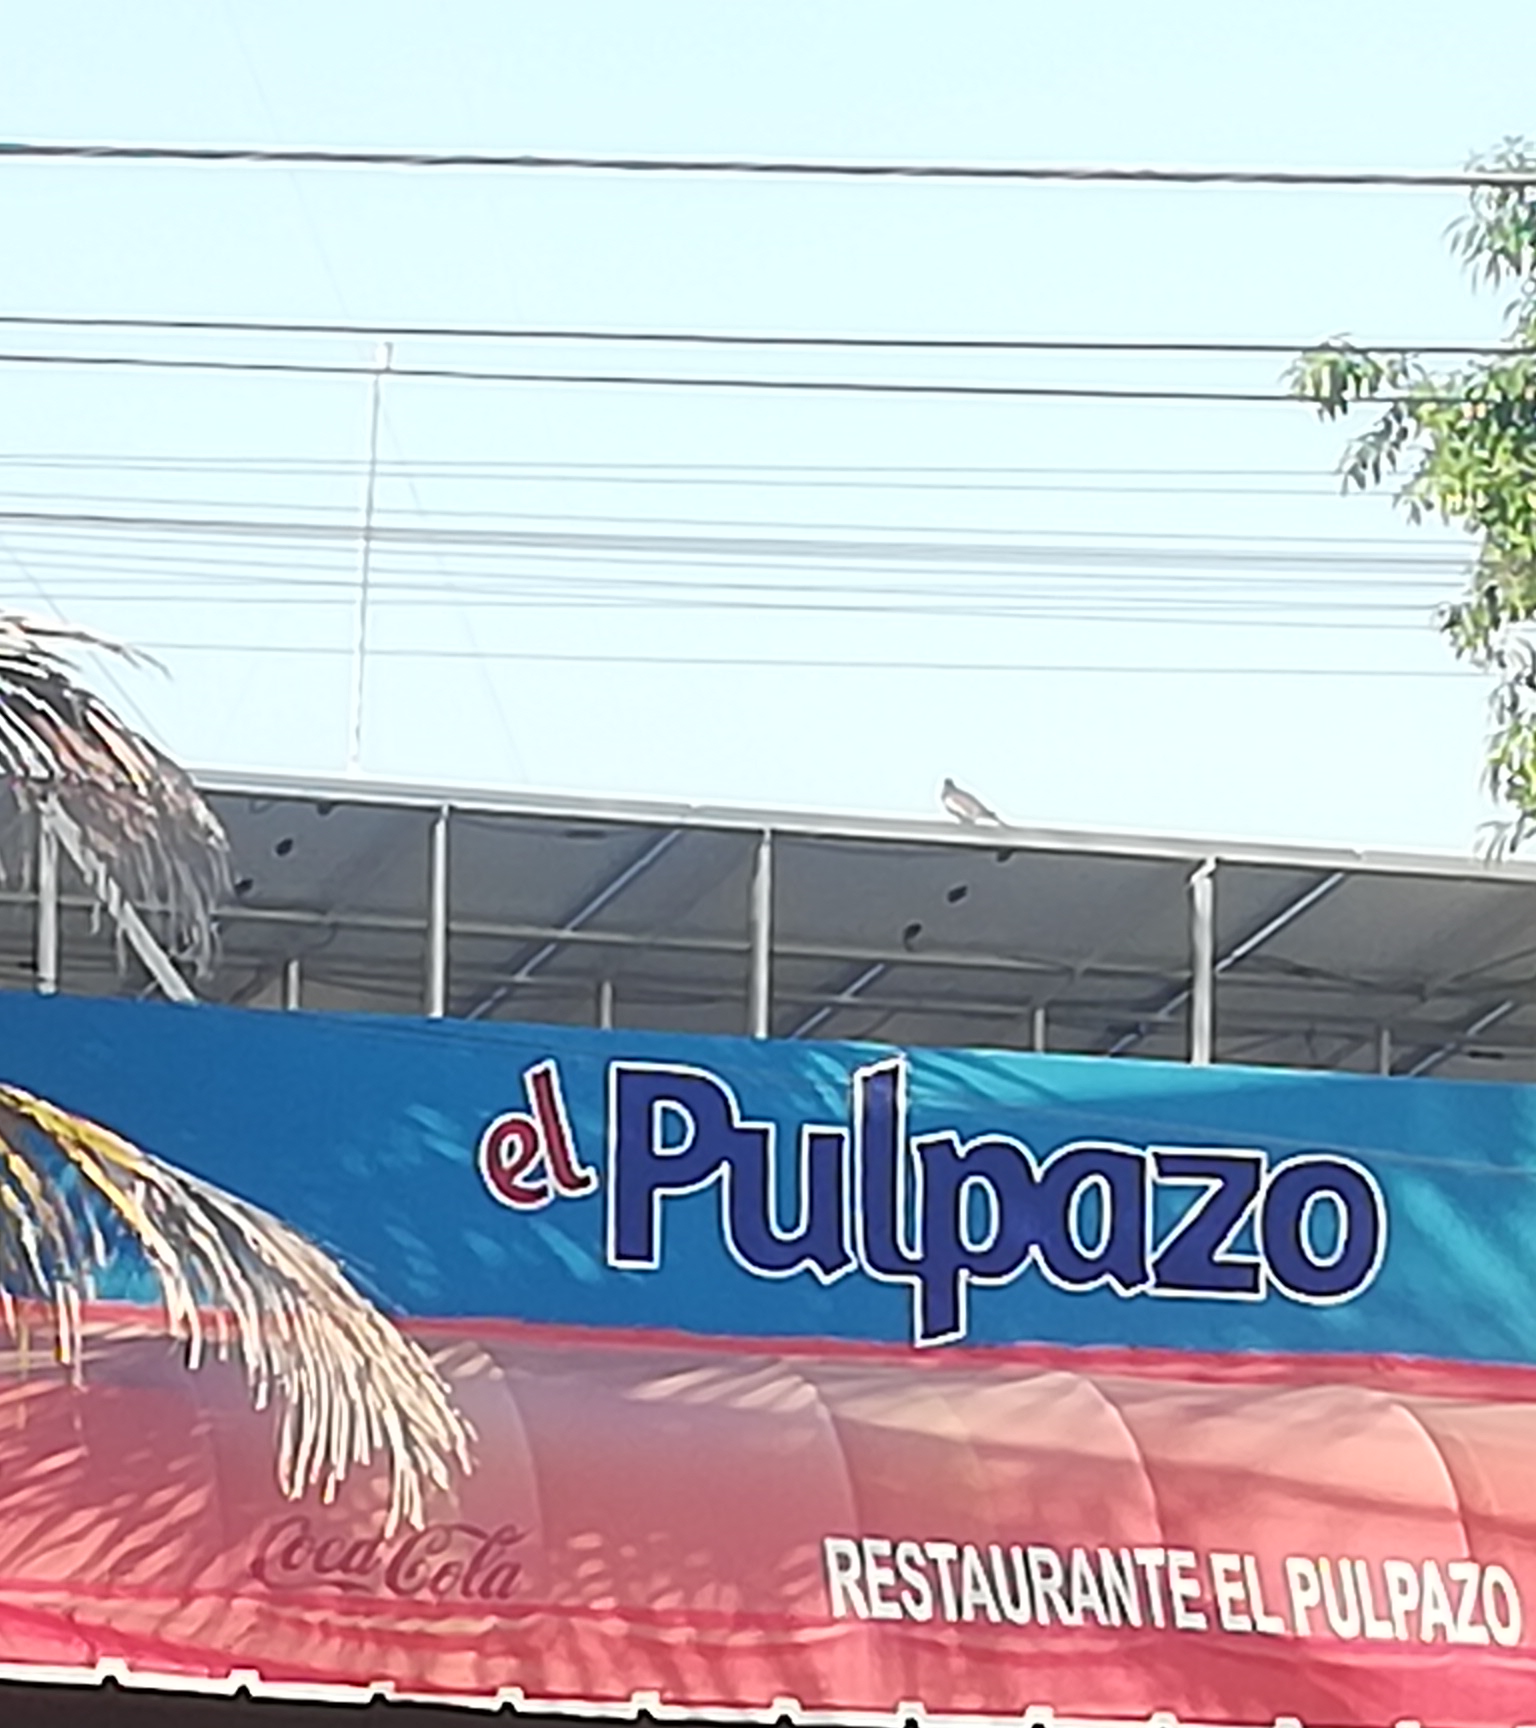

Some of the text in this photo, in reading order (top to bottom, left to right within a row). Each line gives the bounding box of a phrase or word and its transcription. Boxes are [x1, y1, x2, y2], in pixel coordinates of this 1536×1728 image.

[480, 1053, 1386, 1348] el Pulpazo
[824, 1538, 1522, 1646] RESTAURANTE EL PULPAZO
